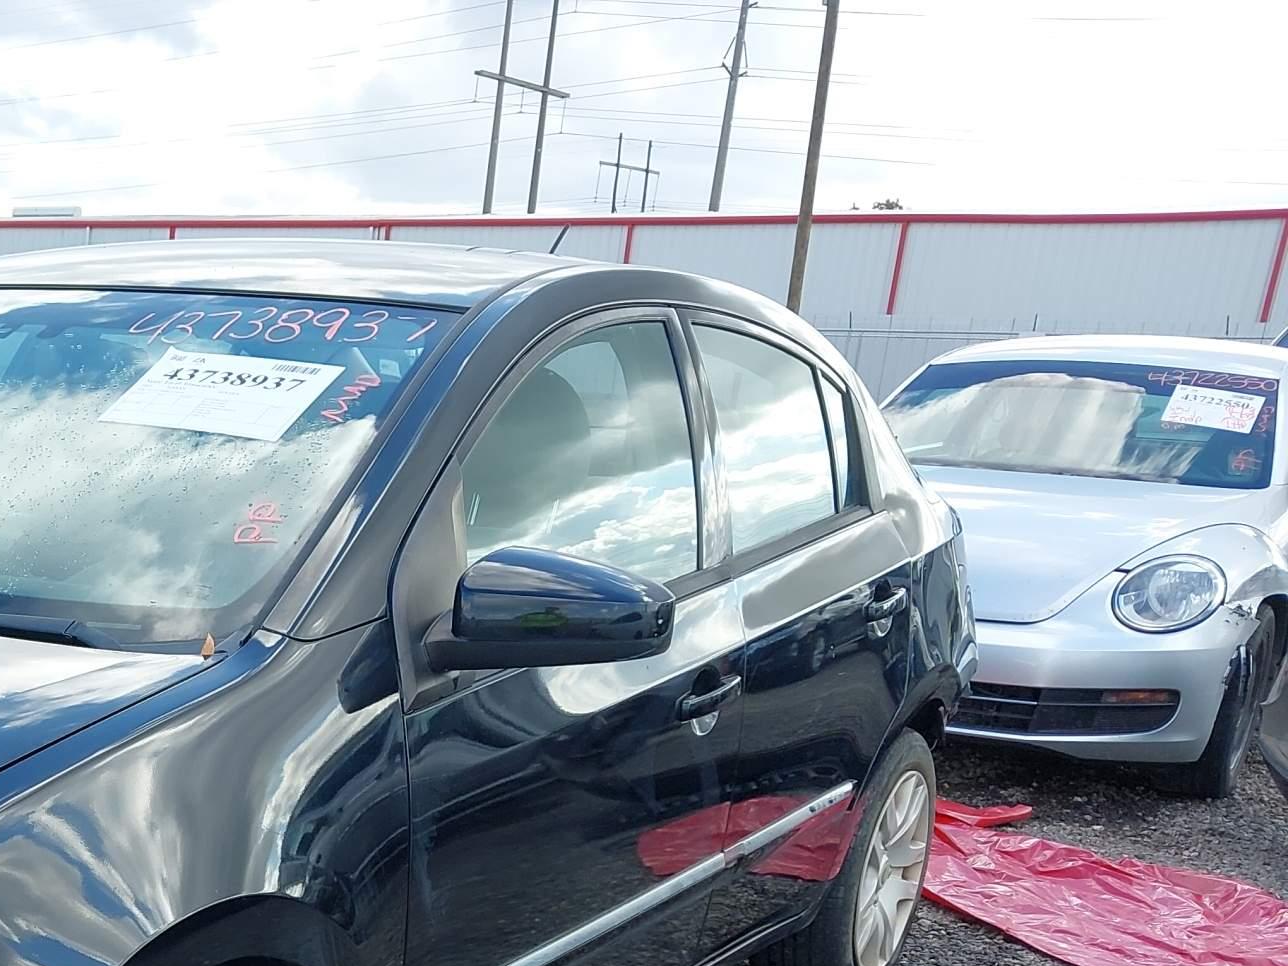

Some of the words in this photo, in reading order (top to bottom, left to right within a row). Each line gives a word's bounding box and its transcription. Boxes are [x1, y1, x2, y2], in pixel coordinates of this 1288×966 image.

[128, 306, 438, 345] 43738937
[163, 367, 307, 392] 43738937
[1148, 369, 1278, 392] 43722550
[1180, 393, 1250, 409] 43722550
